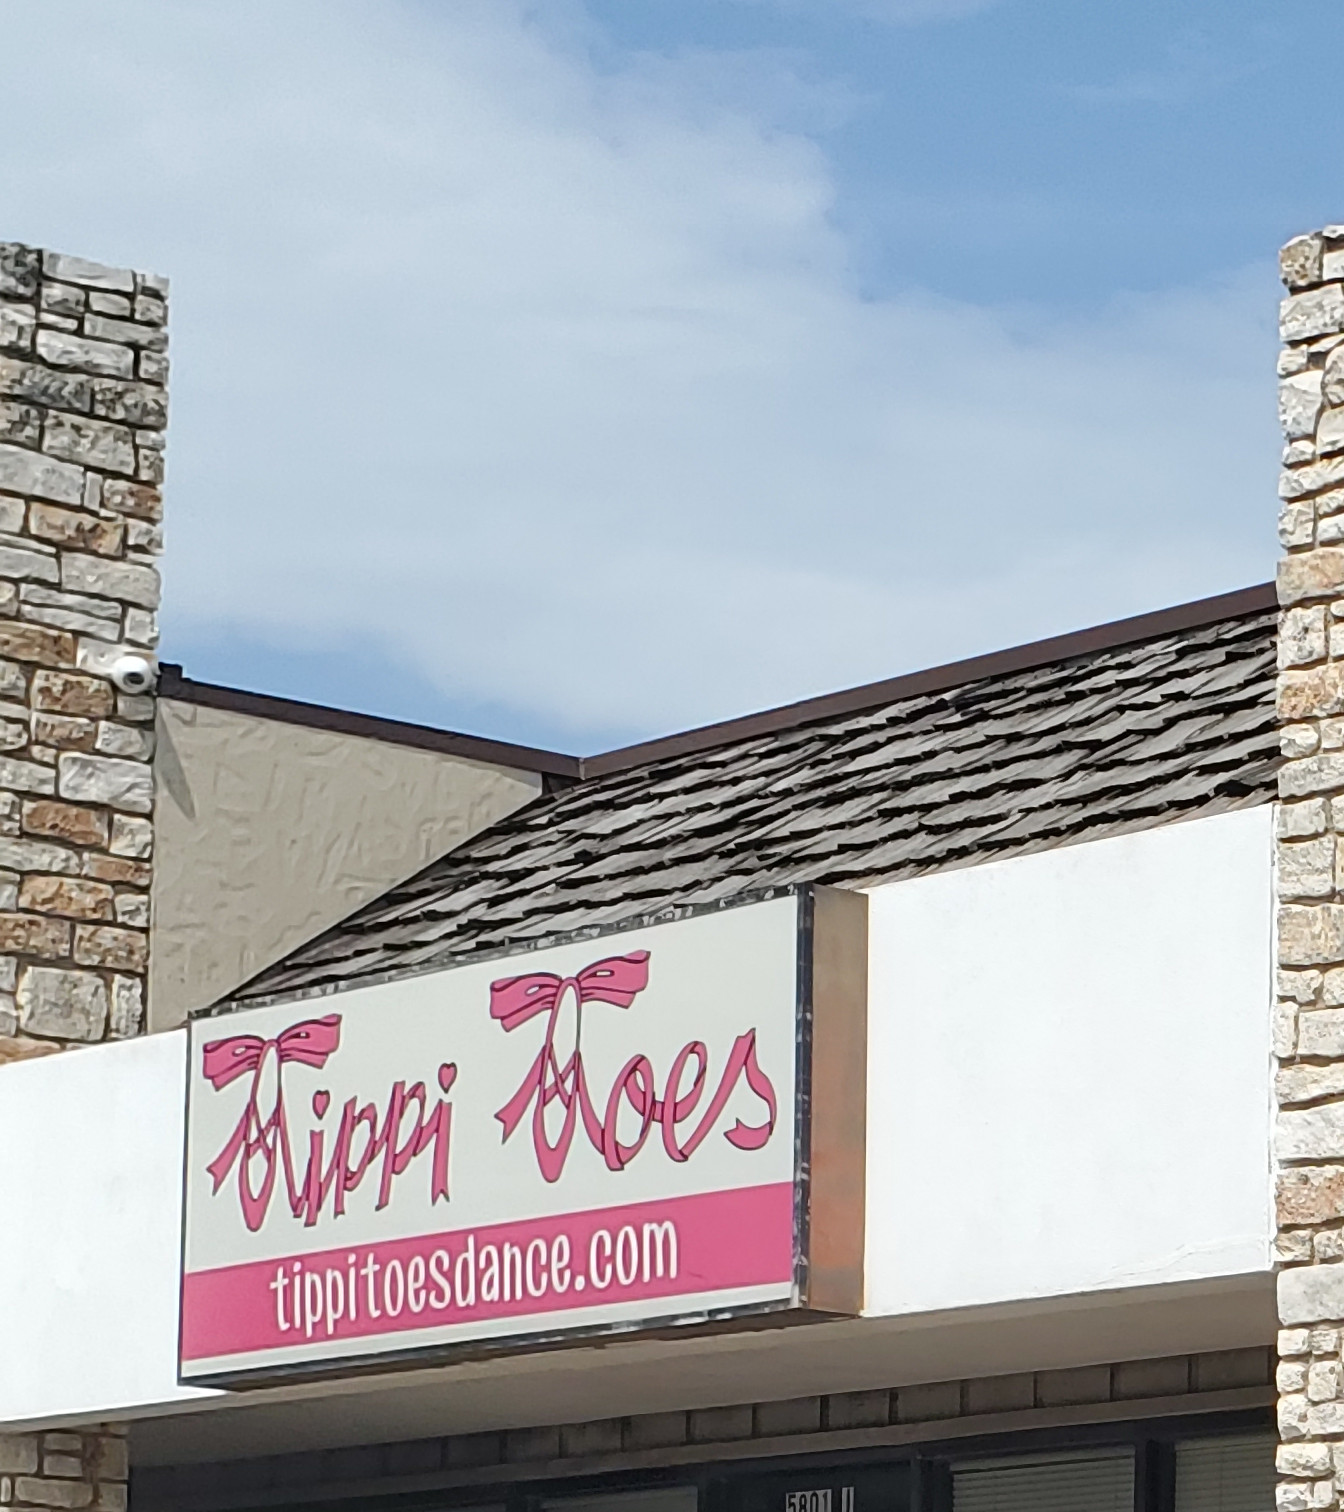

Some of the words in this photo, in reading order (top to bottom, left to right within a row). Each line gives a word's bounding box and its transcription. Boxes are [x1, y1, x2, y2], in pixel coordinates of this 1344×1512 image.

[203, 1013, 457, 1232] Tippi
[489, 949, 777, 1183] Toes
[269, 1219, 678, 1337] tippitoesdance.com
